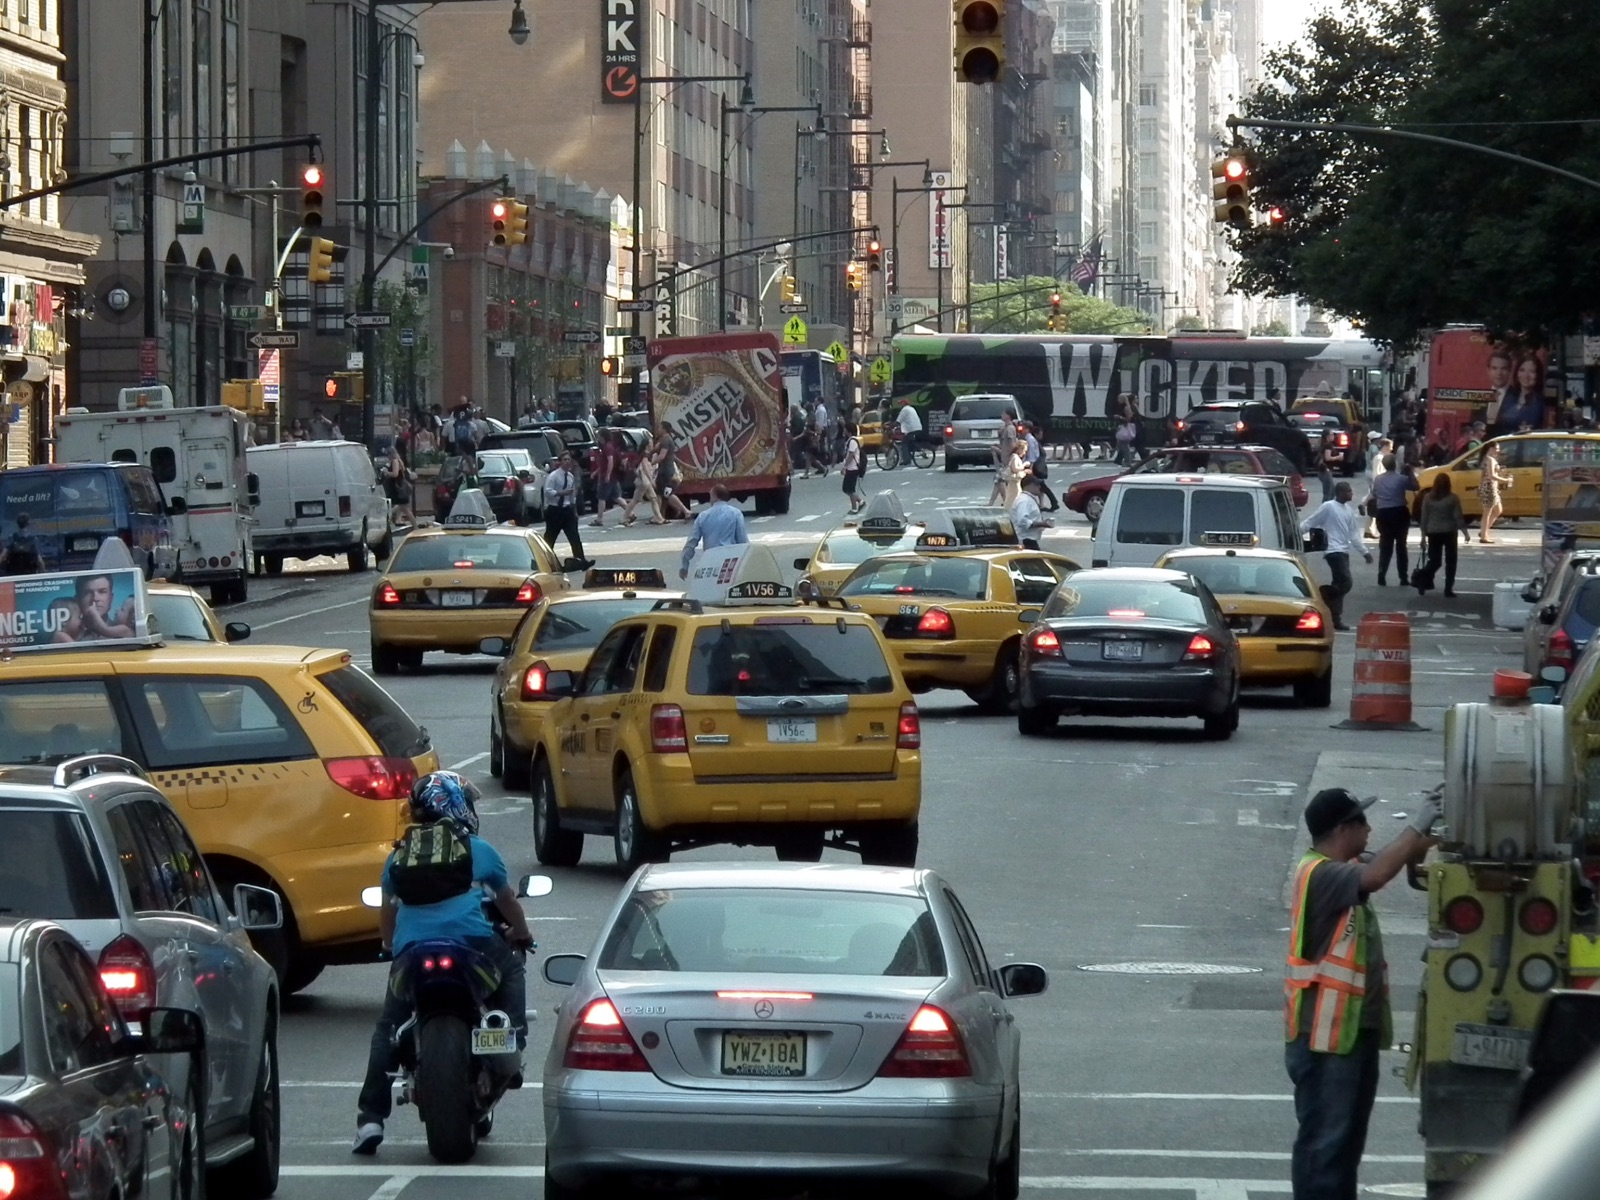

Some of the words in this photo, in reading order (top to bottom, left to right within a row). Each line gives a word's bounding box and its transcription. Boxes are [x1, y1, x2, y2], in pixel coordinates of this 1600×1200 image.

[656, 272, 672, 336] PARK
[889, 304, 901, 312] 30
[231, 308, 237, 317] W
[239, 308, 249, 317] 49
[254, 336, 269, 344] ONE
[1038, 343, 1287, 419] WICKED
[1434, 389, 1465, 398] INSIDE
[670, 381, 741, 448] AMSTEL
[6, 494, 27, 503] Need
[35, 493, 52, 501] lift?
[613, 572, 636, 584] 1A48
[746, 583, 774, 596] 1V56
[899, 605, 918, 614] 864
[0, 607, 71, 636] NGE-UP
[623, 1006, 631, 1014] C
[635, 1006, 666, 1014] 280
